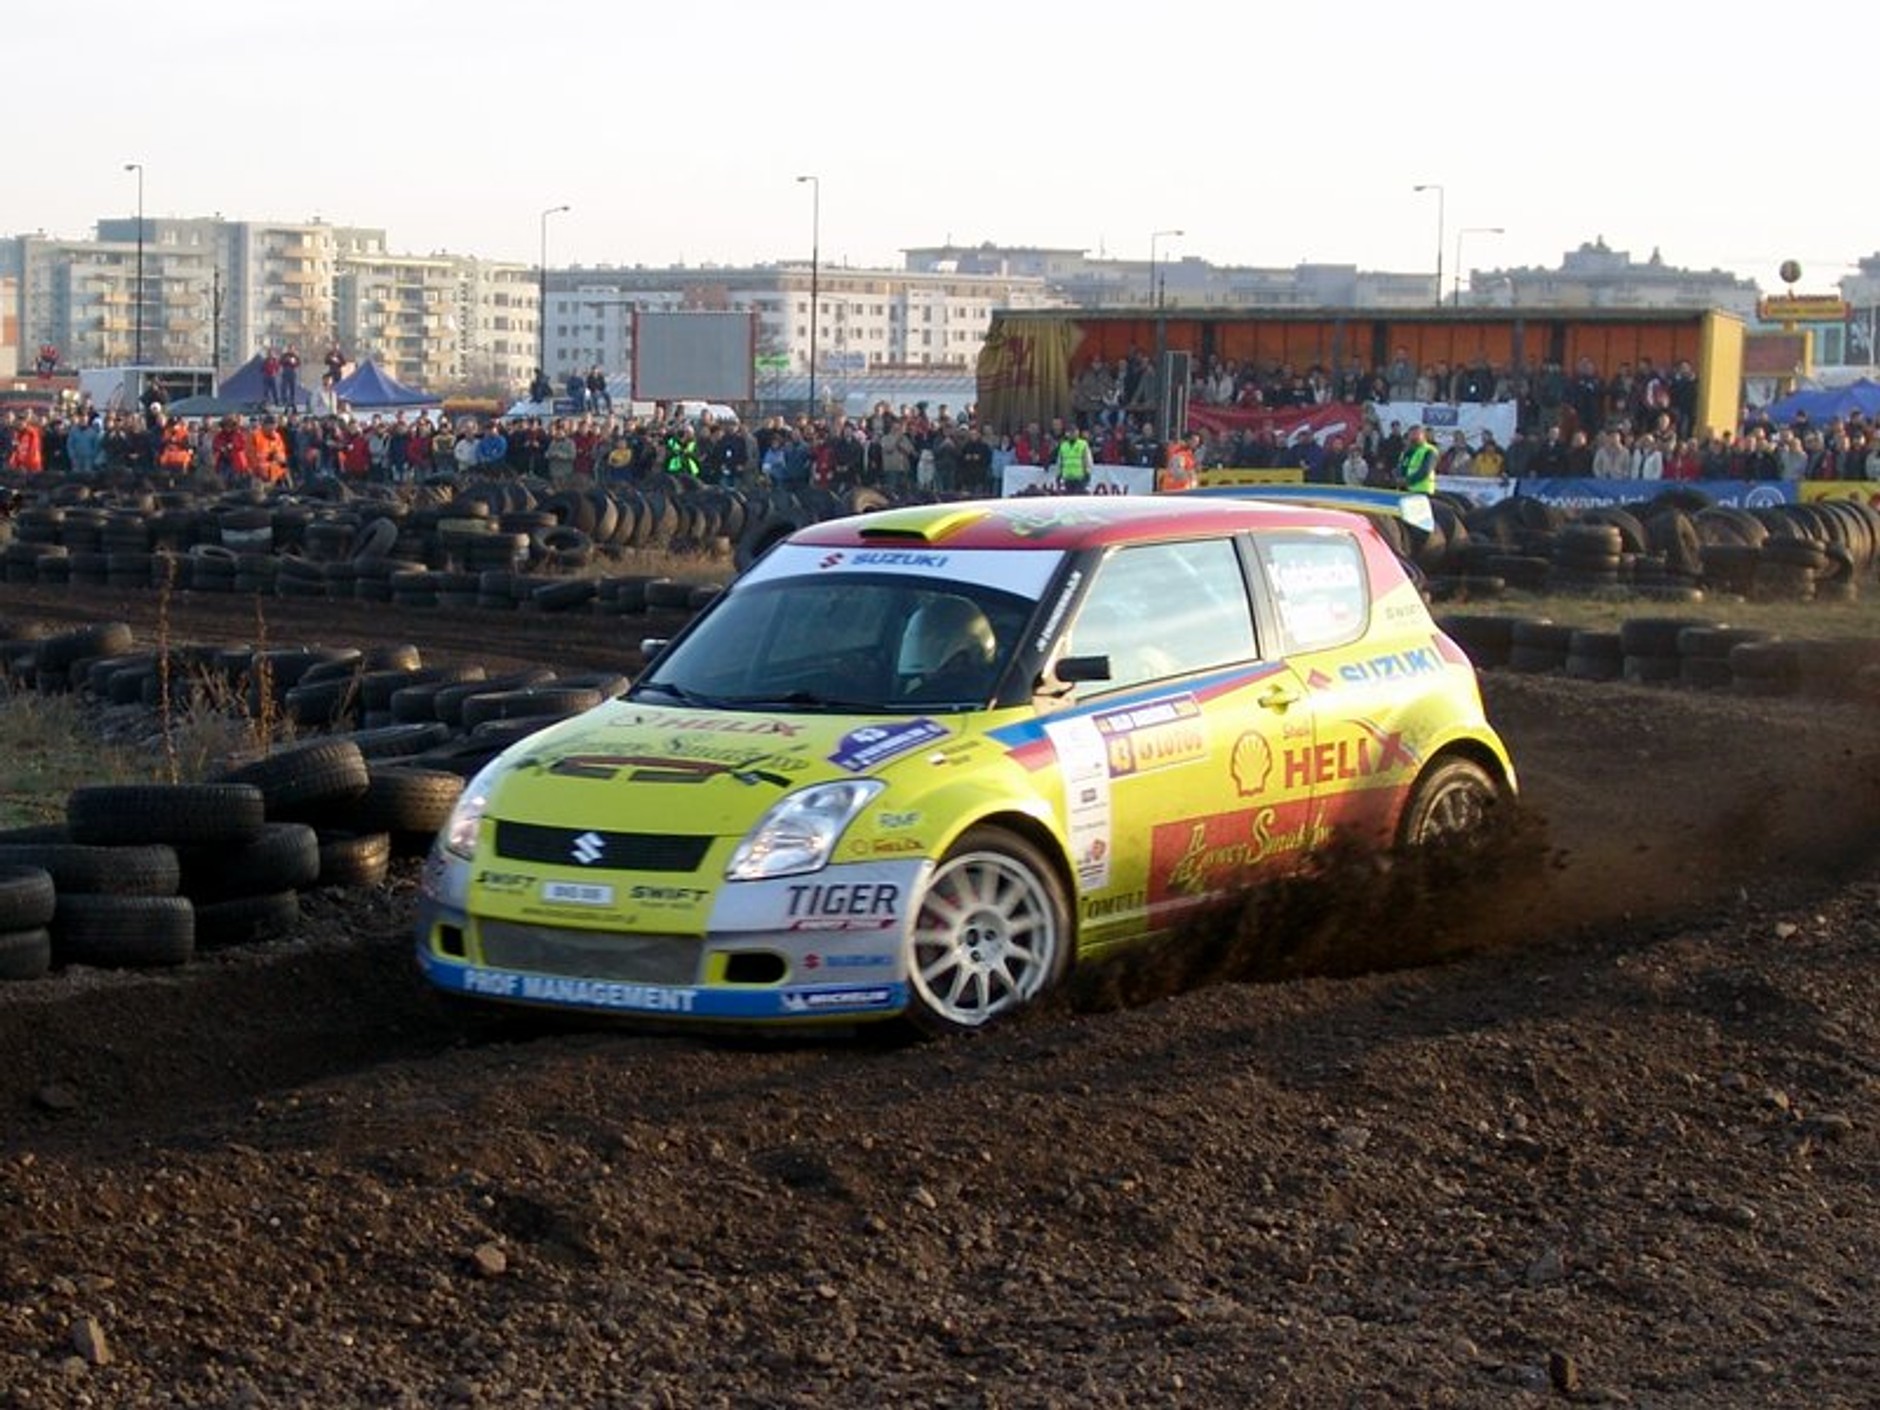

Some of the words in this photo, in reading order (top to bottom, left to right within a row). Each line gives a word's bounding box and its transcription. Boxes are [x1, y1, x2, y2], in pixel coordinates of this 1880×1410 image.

[852, 552, 949, 568] SUZUKI
[1339, 646, 1445, 681] SUZUKI
[1284, 731, 1414, 789] HELIX
[475, 870, 537, 888] SWIFT
[629, 885, 711, 902] SWIFT
[787, 883, 900, 916] TIGER
[463, 969, 520, 996] PROF
[521, 975, 698, 1012] MANAGEMENT
